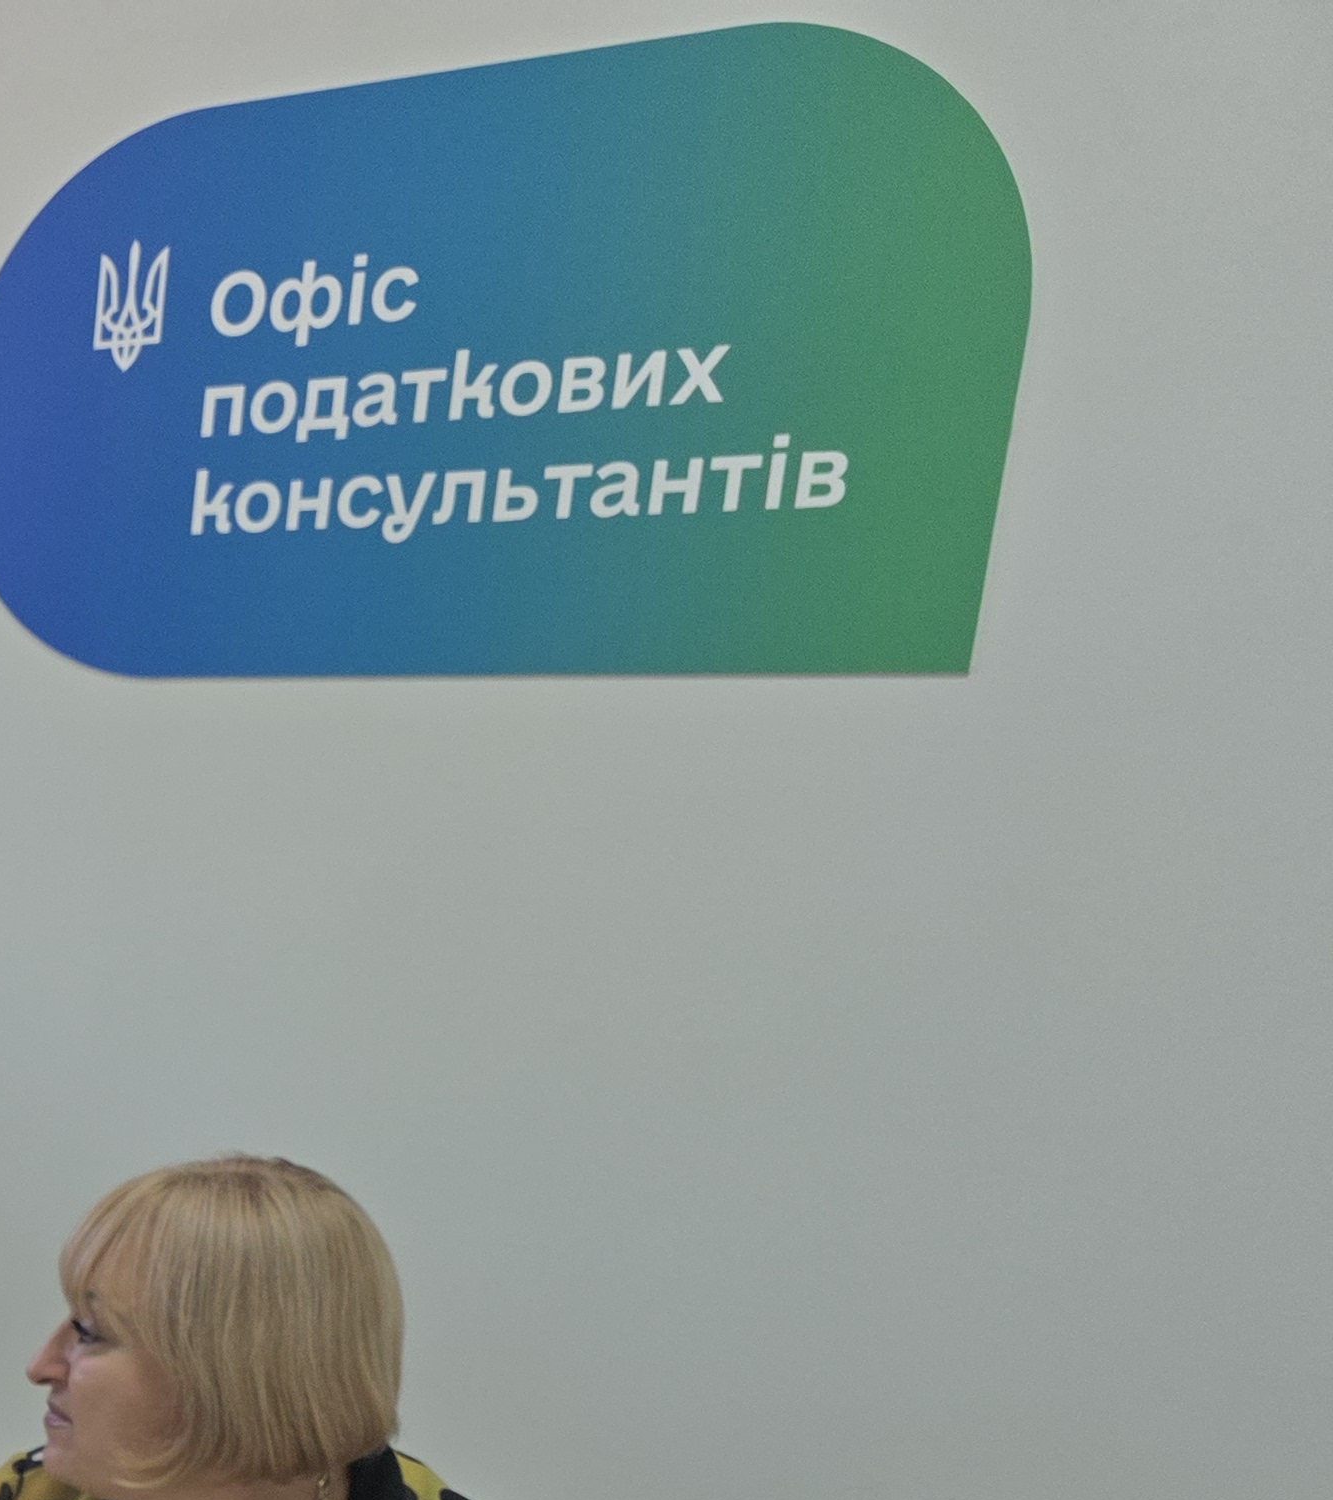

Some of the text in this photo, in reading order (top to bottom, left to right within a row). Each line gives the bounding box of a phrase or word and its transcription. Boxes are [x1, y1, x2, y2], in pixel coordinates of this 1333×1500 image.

[210, 253, 419, 347] Офіс
[200, 343, 731, 443] податкових
[190, 433, 849, 544] консультантів
